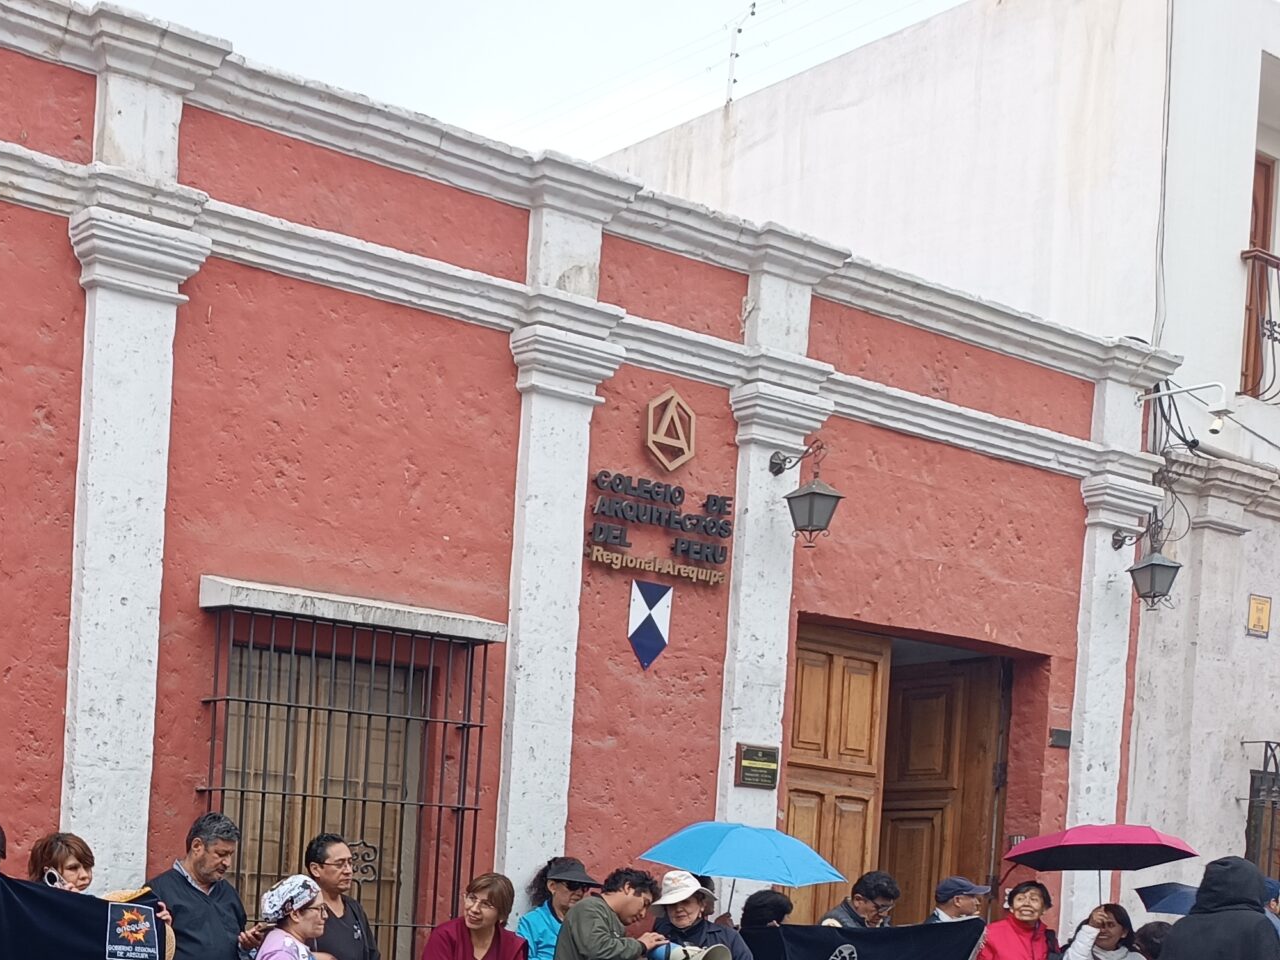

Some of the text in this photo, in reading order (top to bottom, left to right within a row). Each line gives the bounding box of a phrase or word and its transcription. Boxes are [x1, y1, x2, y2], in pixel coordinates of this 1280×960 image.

[595, 470, 733, 515] COLEGIO DE
[593, 495, 732, 538] ARQUITECTOS
[591, 522, 728, 564] DEL PERU
